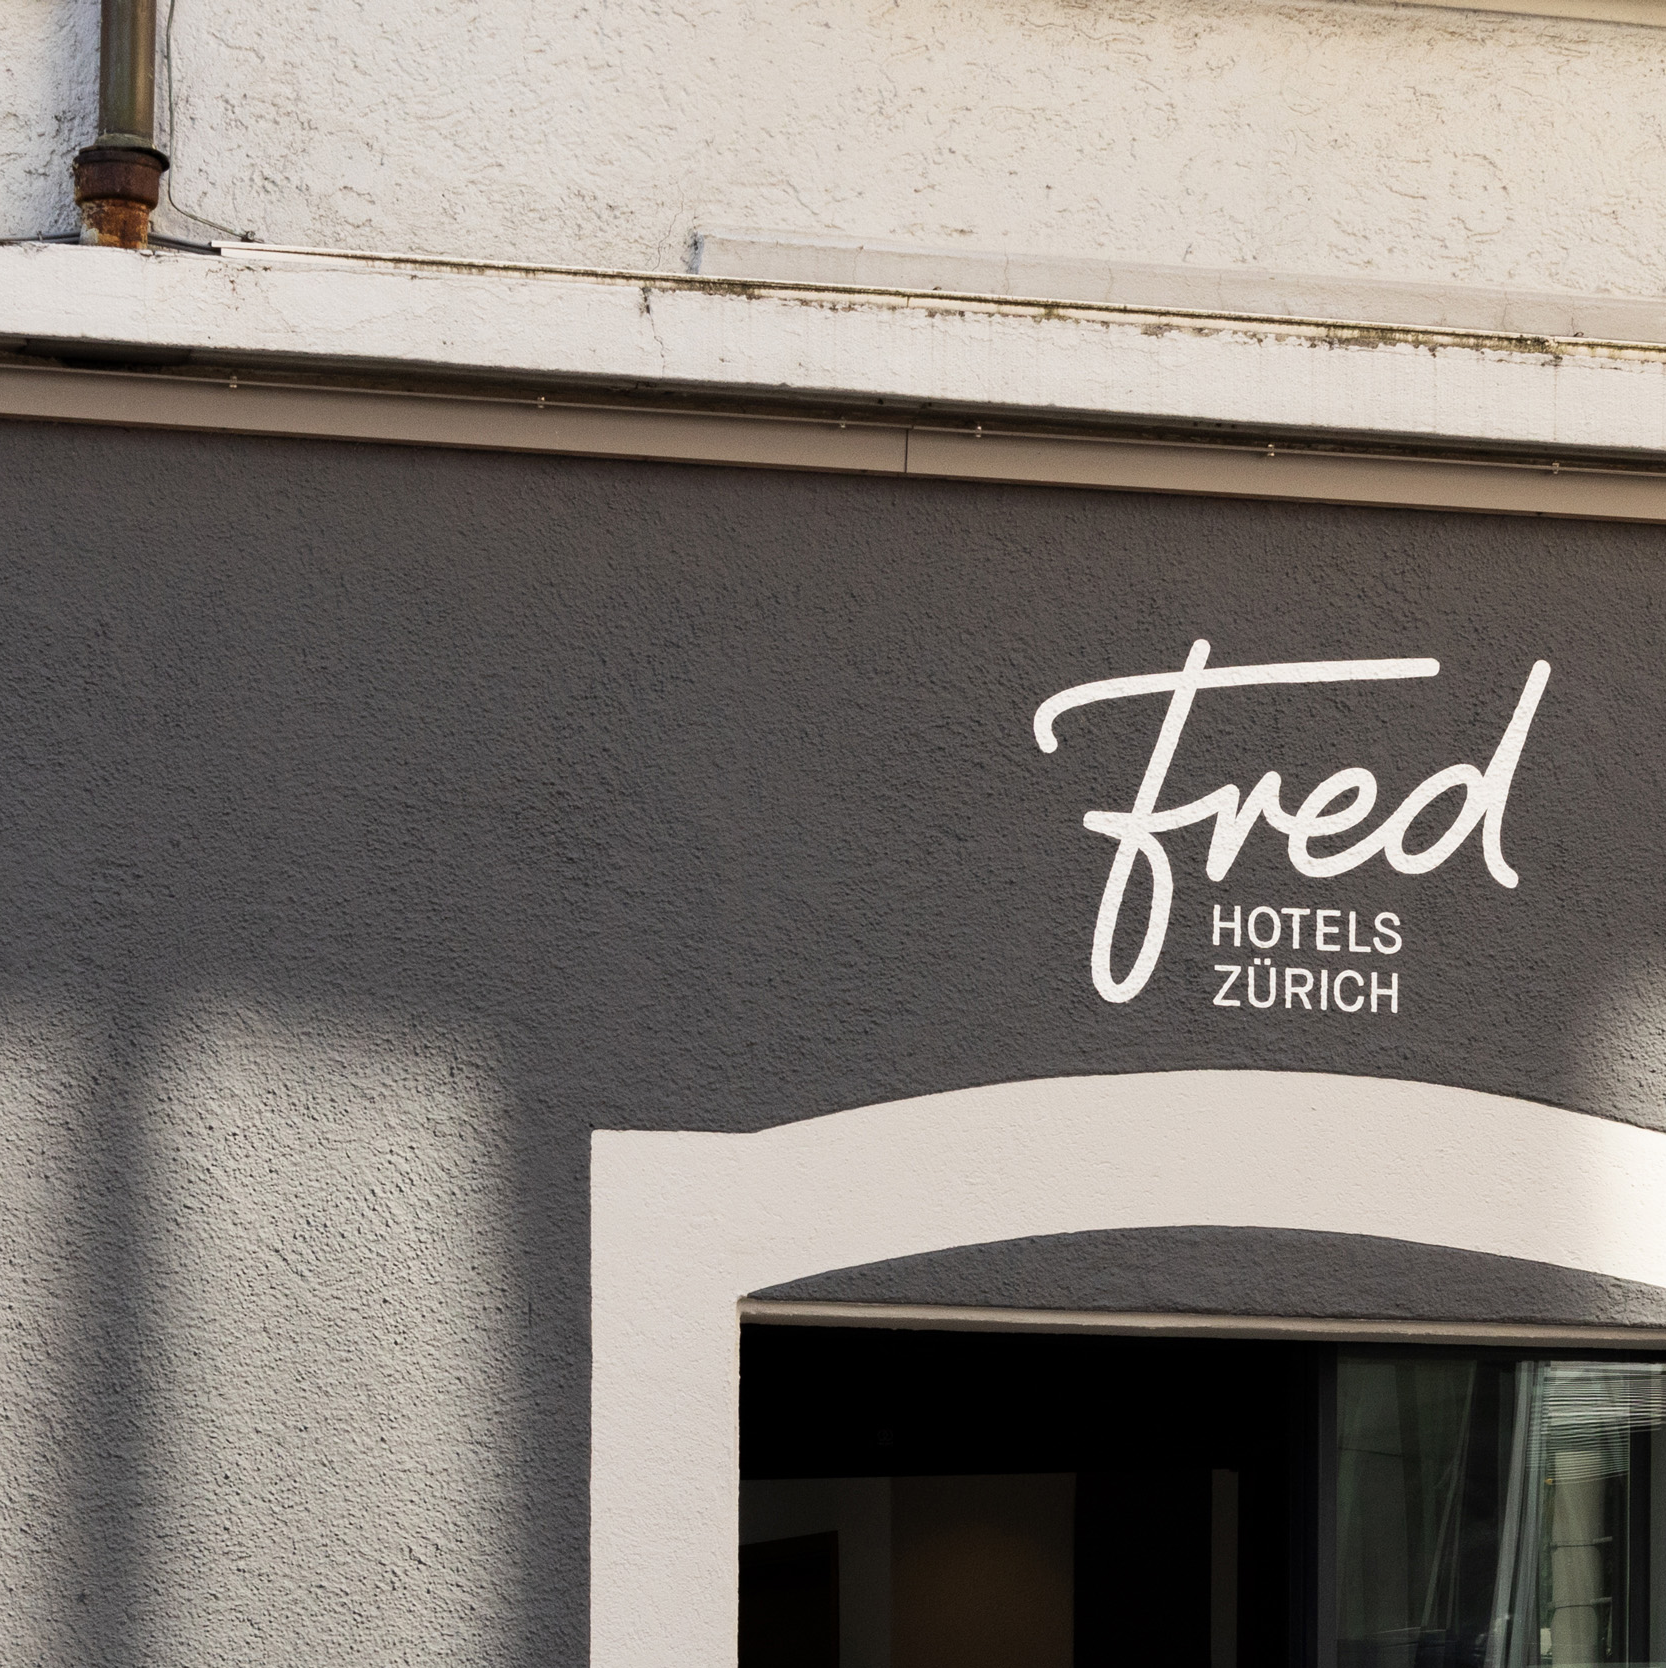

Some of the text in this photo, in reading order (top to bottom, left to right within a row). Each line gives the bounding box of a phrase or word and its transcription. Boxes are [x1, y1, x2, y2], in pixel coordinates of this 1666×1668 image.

[1033, 638, 1552, 1004] Fred
[1212, 904, 1403, 955] HOTELS
[1212, 957, 1400, 1014] ZÜRICH
